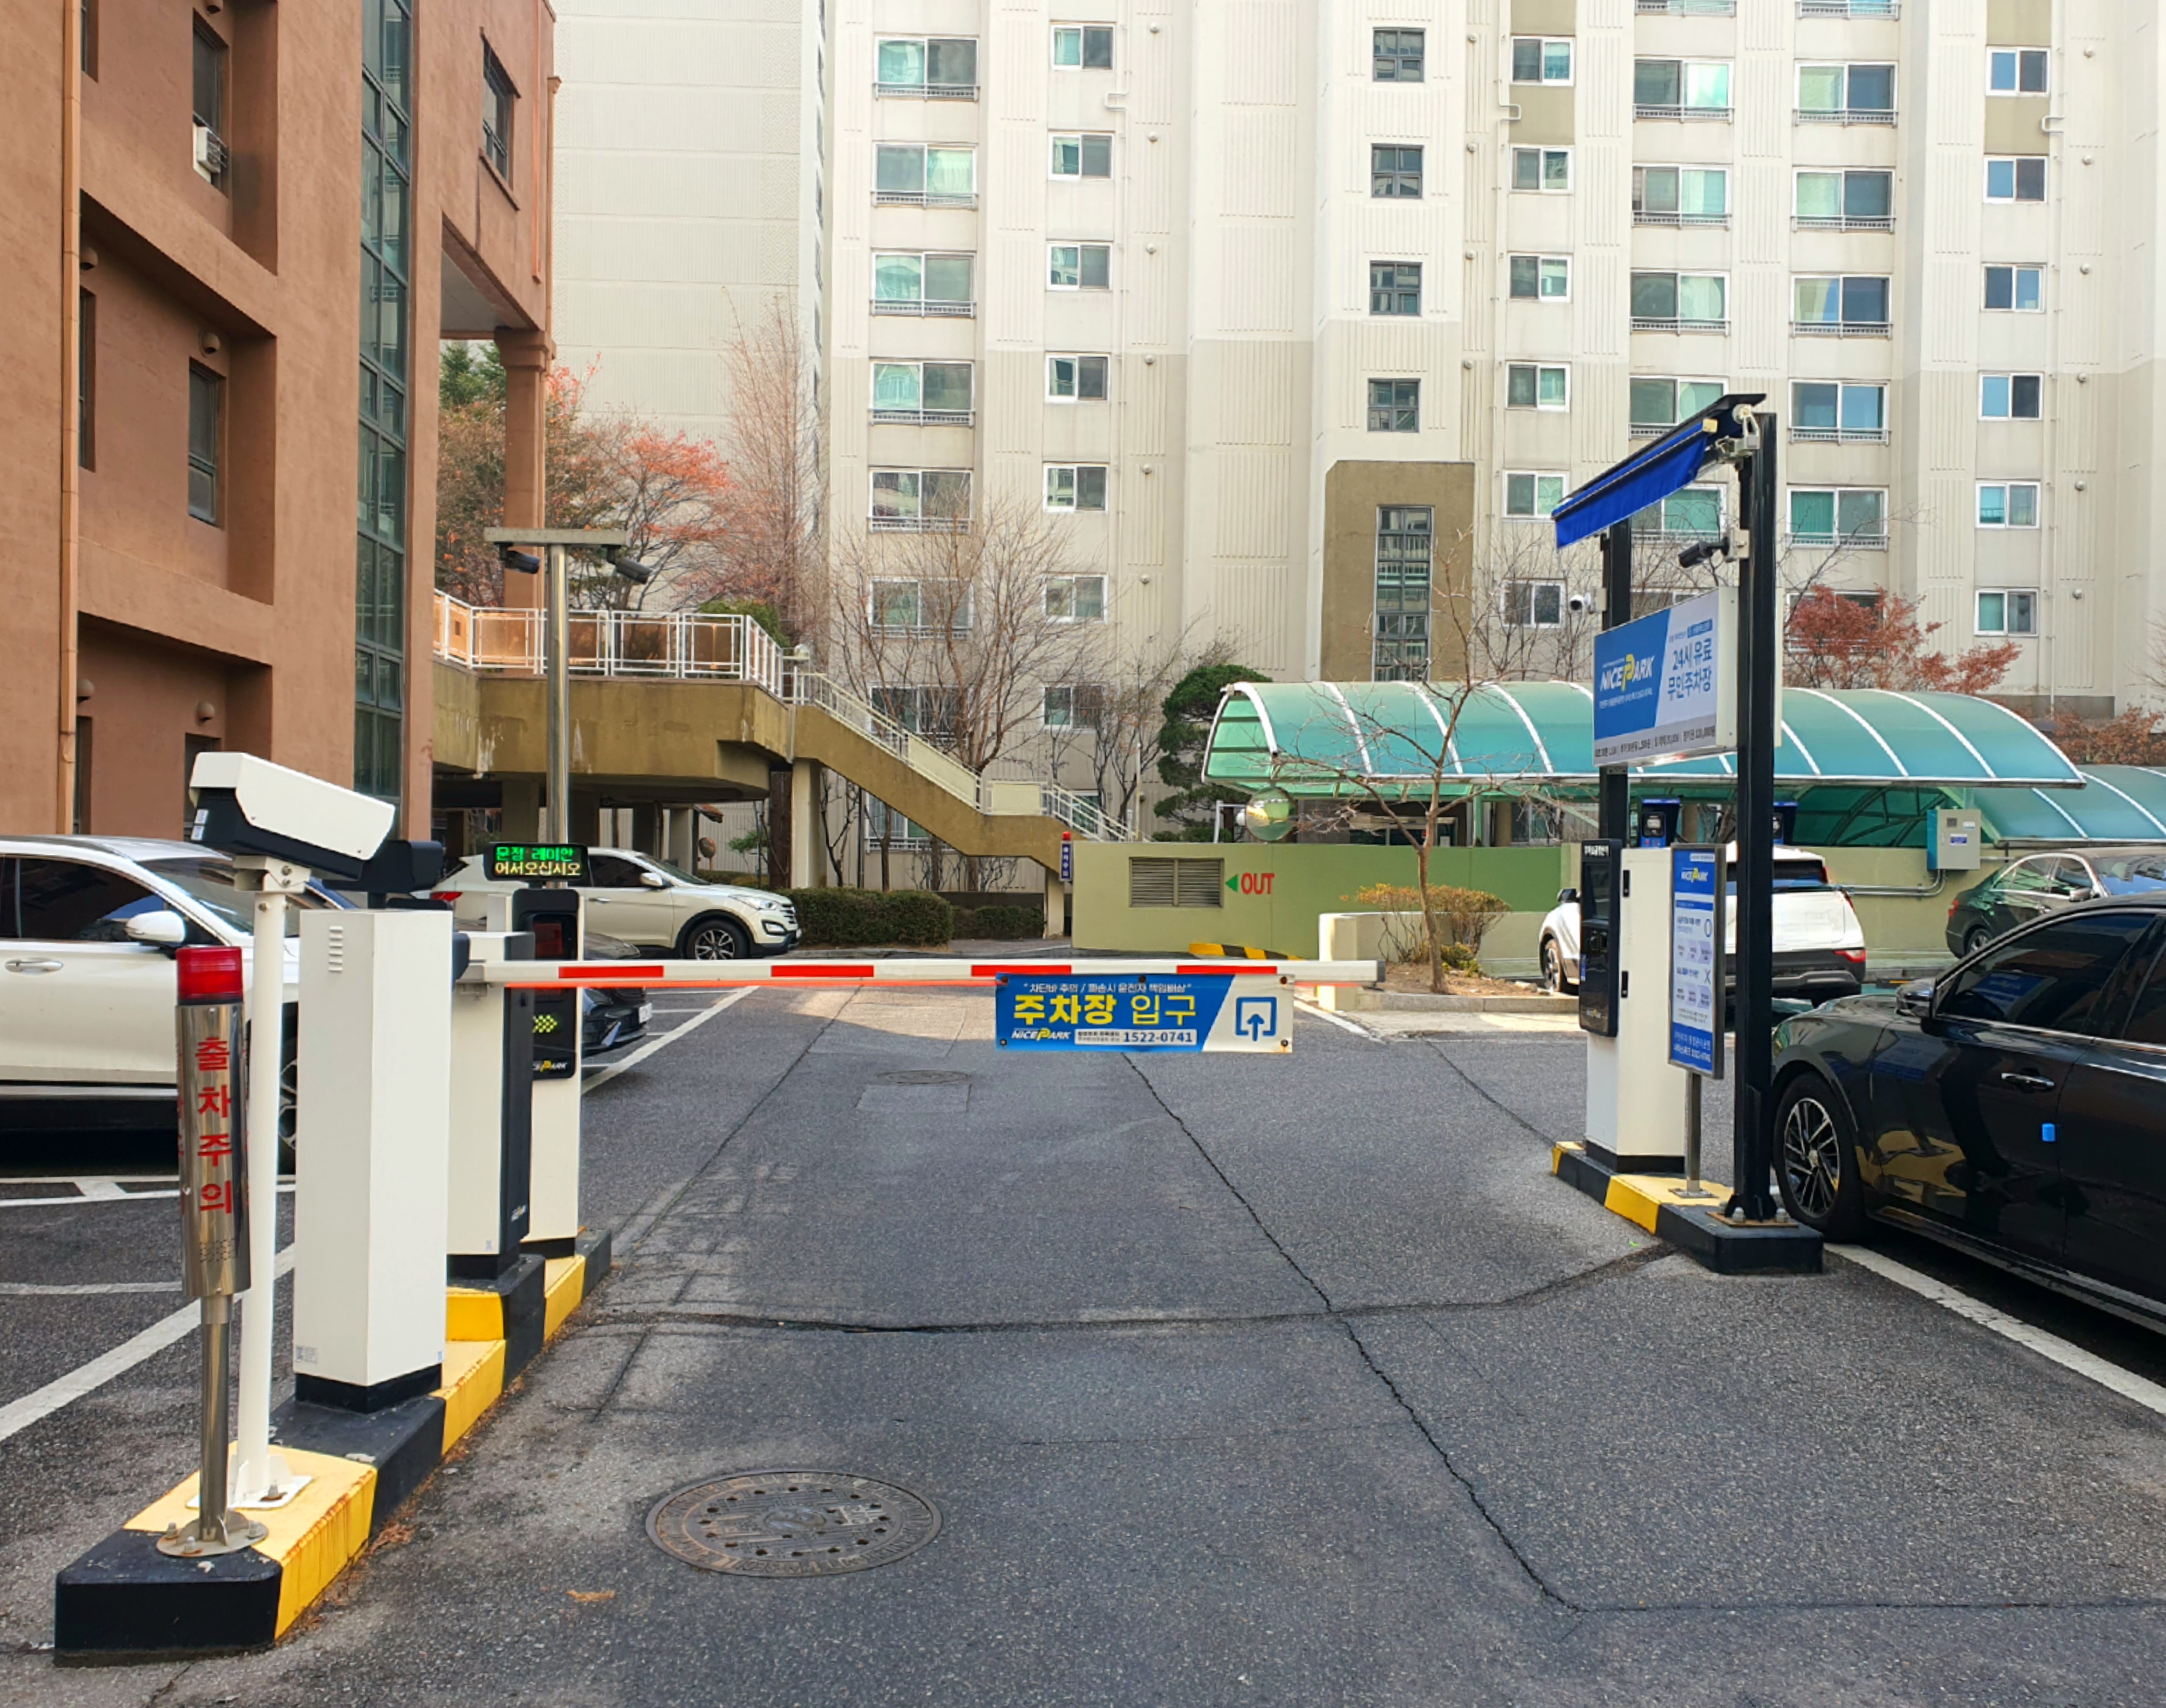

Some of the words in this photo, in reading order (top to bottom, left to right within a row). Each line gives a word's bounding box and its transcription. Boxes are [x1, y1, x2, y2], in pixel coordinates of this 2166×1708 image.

[1673, 642, 1693, 671] 24시
[1693, 637, 1712, 666] 유료
[1667, 665, 1712, 702] 무인주차장
[496, 846, 524, 861] 문정
[495, 861, 581, 876] 어서오십시오
[1240, 872, 1275, 895] OUT
[1060, 983, 1079, 993] 주의
[1013, 995, 1117, 1025] 주차장
[1130, 995, 1196, 1026] 입구
[1011, 1027, 1072, 1042] NICEPARK
[1123, 1031, 1193, 1043] 1522-0741
[195, 1036, 232, 1215] 출차주의
